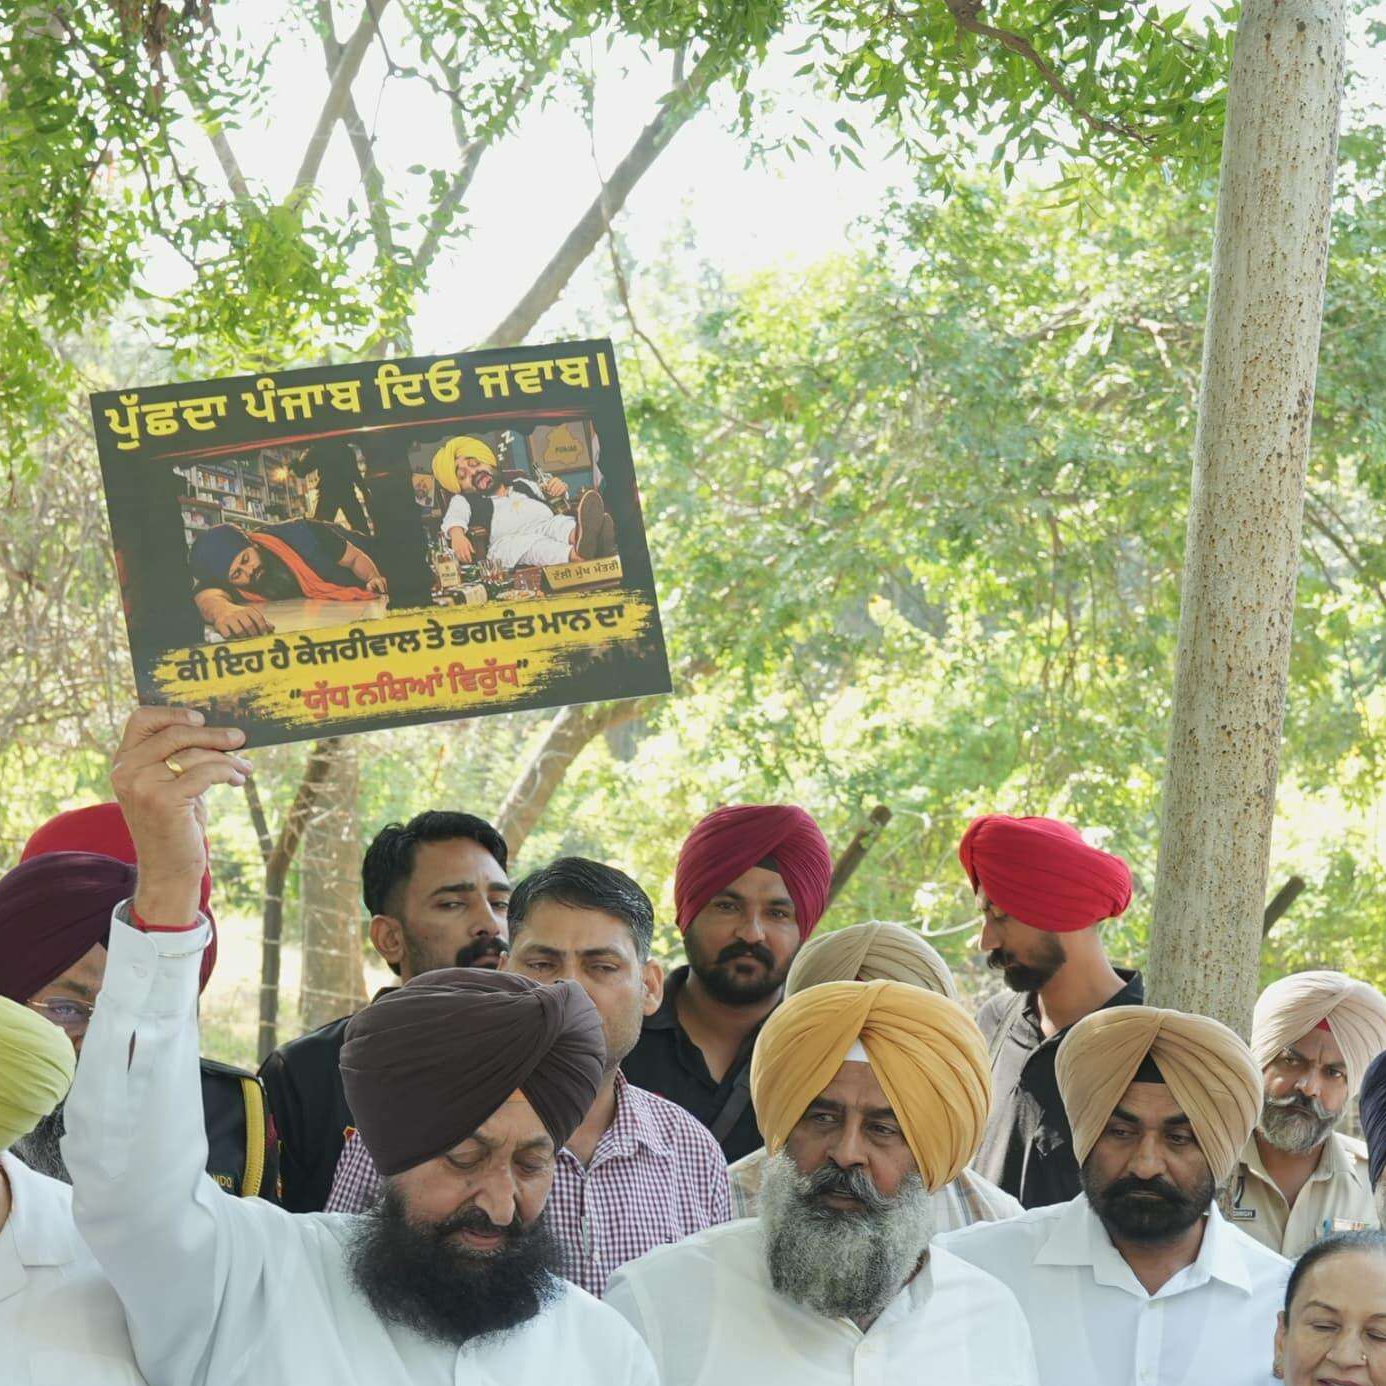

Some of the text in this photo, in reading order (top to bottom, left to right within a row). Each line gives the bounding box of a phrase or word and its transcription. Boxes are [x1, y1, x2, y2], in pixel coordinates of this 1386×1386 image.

[105, 352, 610, 450] ਪੁੱਛਦਾ ਪੰਜਾਬ ਦਿਓ ਜਵਾਬ।
[175, 602, 624, 682] ਕੀ ਇਹ ਹੈ ਕੇਜਰੀਵਾਲ ਤੇ ਭਗਵੰਤ ਮਾਨ ਦਾ
